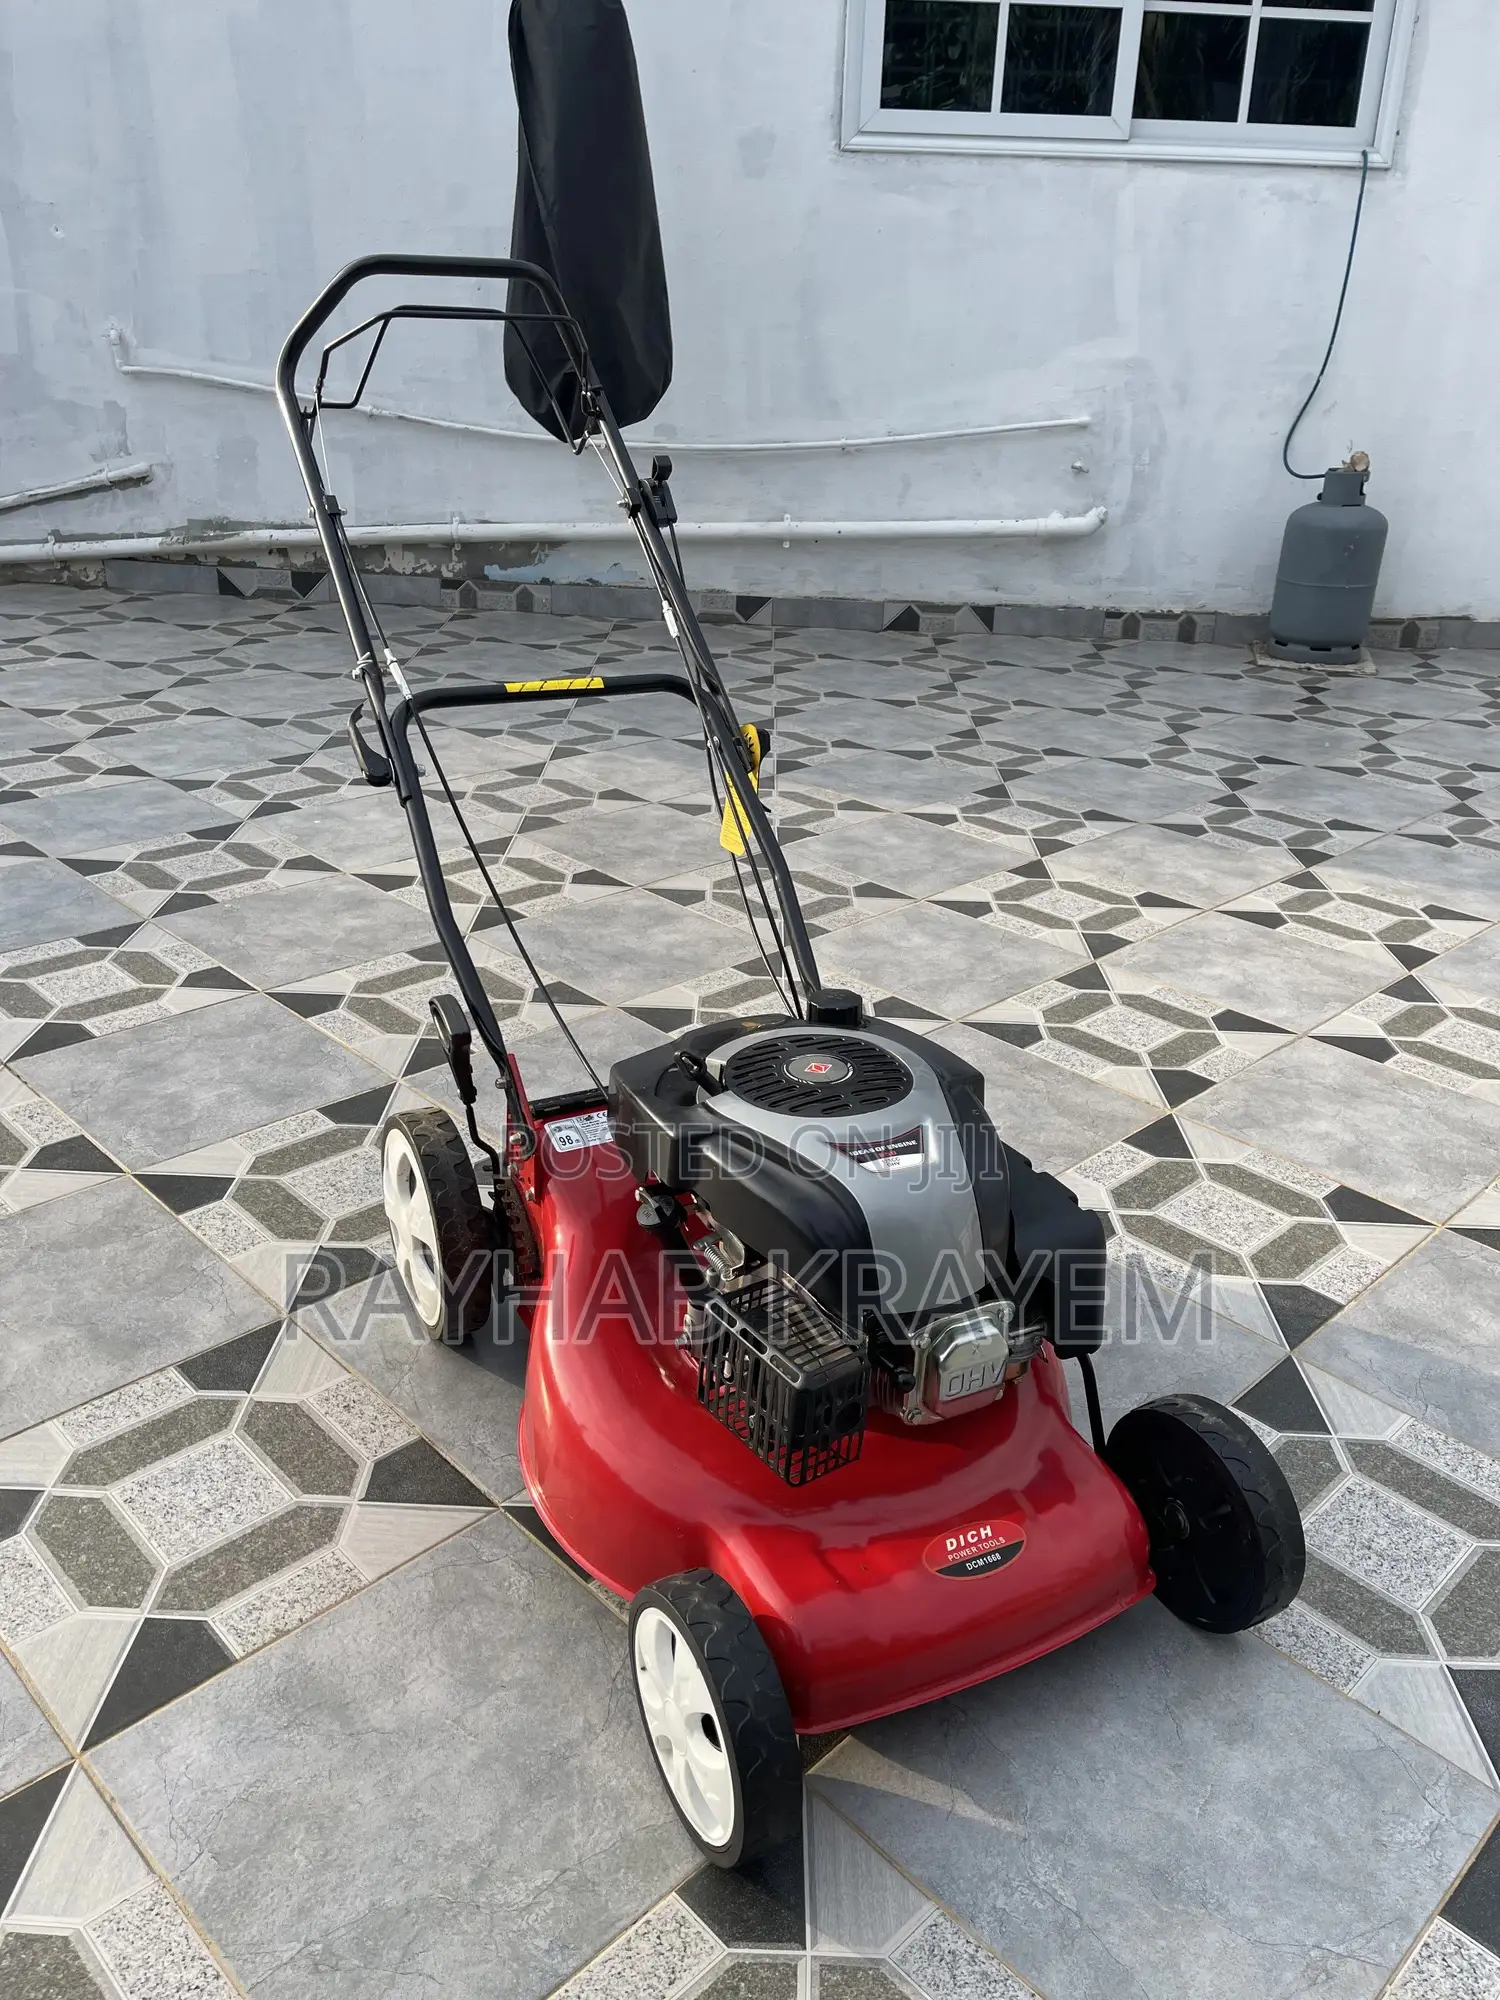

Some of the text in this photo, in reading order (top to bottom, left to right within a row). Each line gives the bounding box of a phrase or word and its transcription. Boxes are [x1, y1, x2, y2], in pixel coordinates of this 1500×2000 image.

[559, 1135, 574, 1146] 98
[945, 1359, 1007, 1397] OHV
[945, 1525, 993, 1552] DICH
[948, 1536, 1006, 1562] POWER TOOLS
[966, 1552, 1002, 1571] DCM1668
